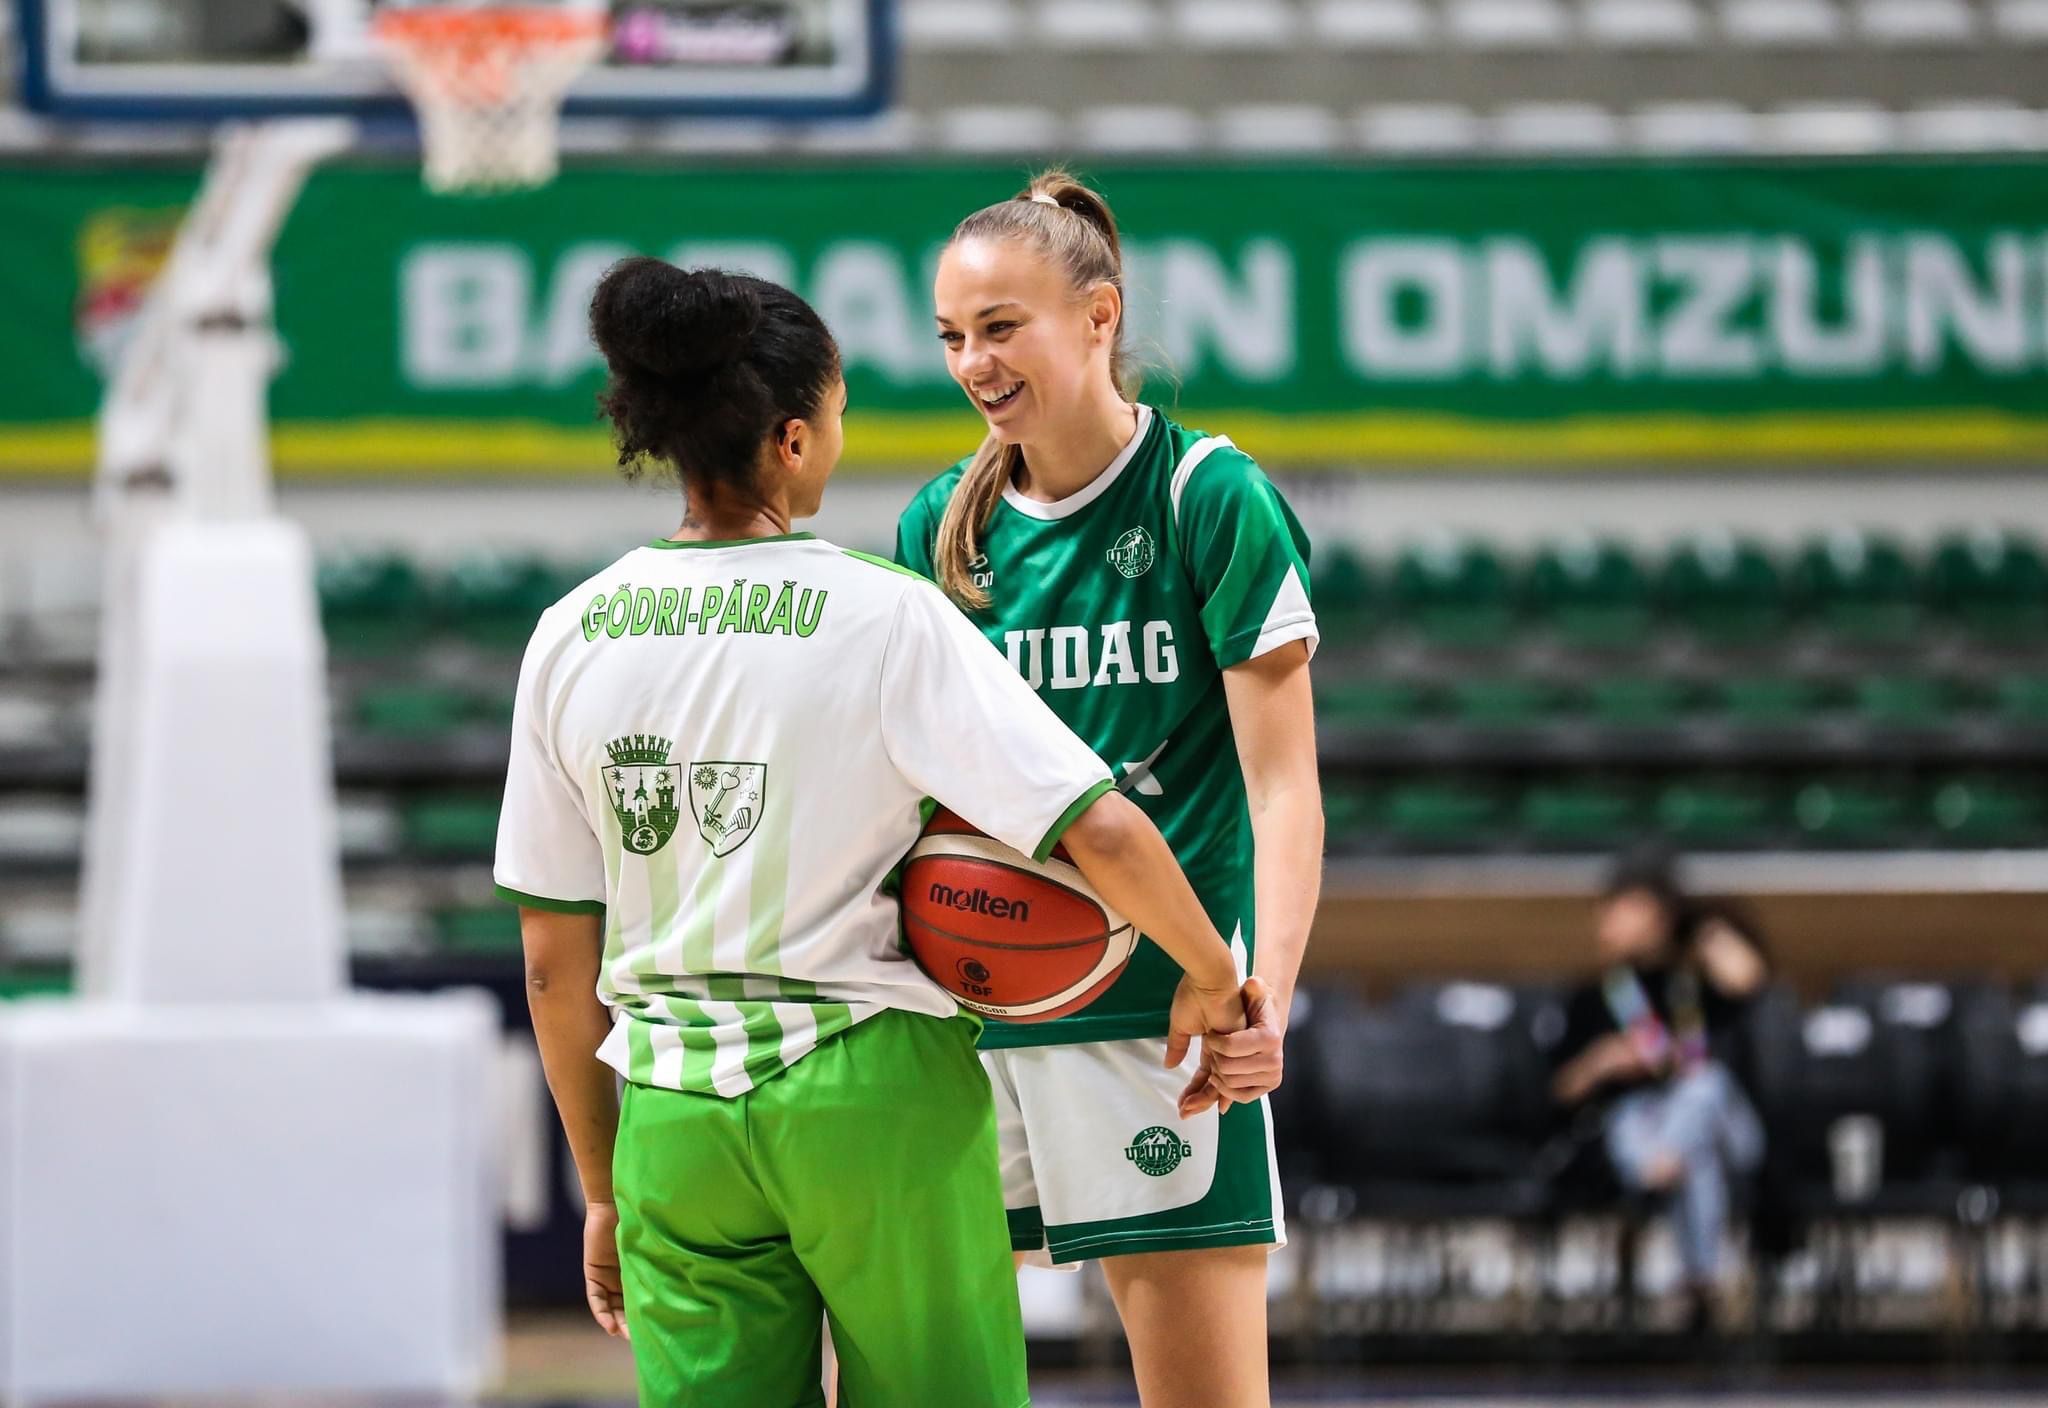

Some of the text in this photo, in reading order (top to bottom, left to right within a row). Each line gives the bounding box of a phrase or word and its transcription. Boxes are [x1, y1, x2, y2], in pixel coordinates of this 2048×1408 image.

[1340, 232, 2048, 380] OMZUN
[581, 578, 829, 643] GÖDRI-PĂRĂU
[929, 882, 1030, 923] molten
[959, 979, 993, 997] TBF
